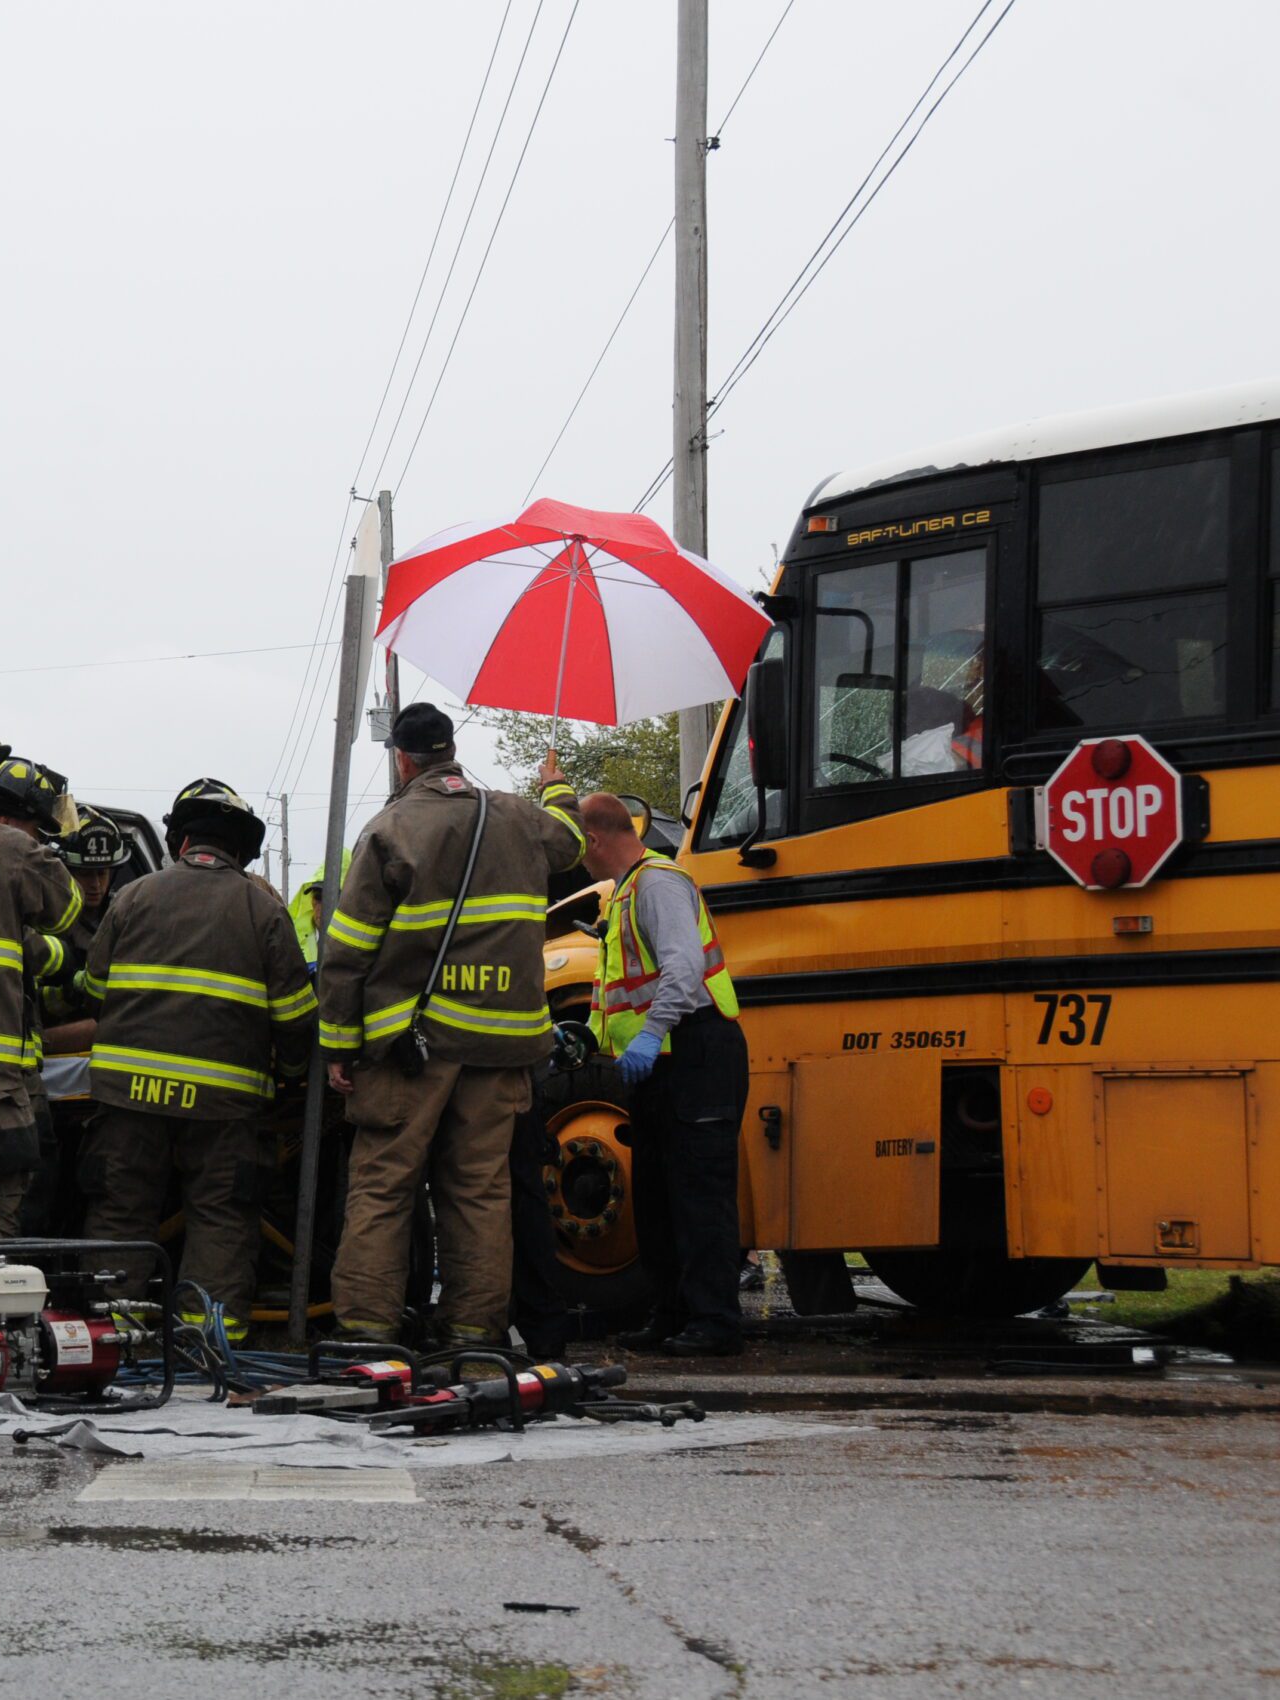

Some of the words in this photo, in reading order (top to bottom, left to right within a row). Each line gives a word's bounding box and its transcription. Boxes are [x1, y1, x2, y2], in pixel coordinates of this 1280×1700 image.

[847, 514, 956, 546] SAF-T-LINER
[962, 510, 991, 526] C2
[1061, 784, 1162, 842] STOP
[87, 836, 109, 855] 41
[442, 964, 511, 992] HNFD
[1034, 993, 1112, 1046] 737
[842, 1032, 882, 1050] DOT
[890, 1030, 966, 1049] 350651
[130, 1074, 197, 1108] HNFD
[875, 1138, 914, 1158] BATTERY
